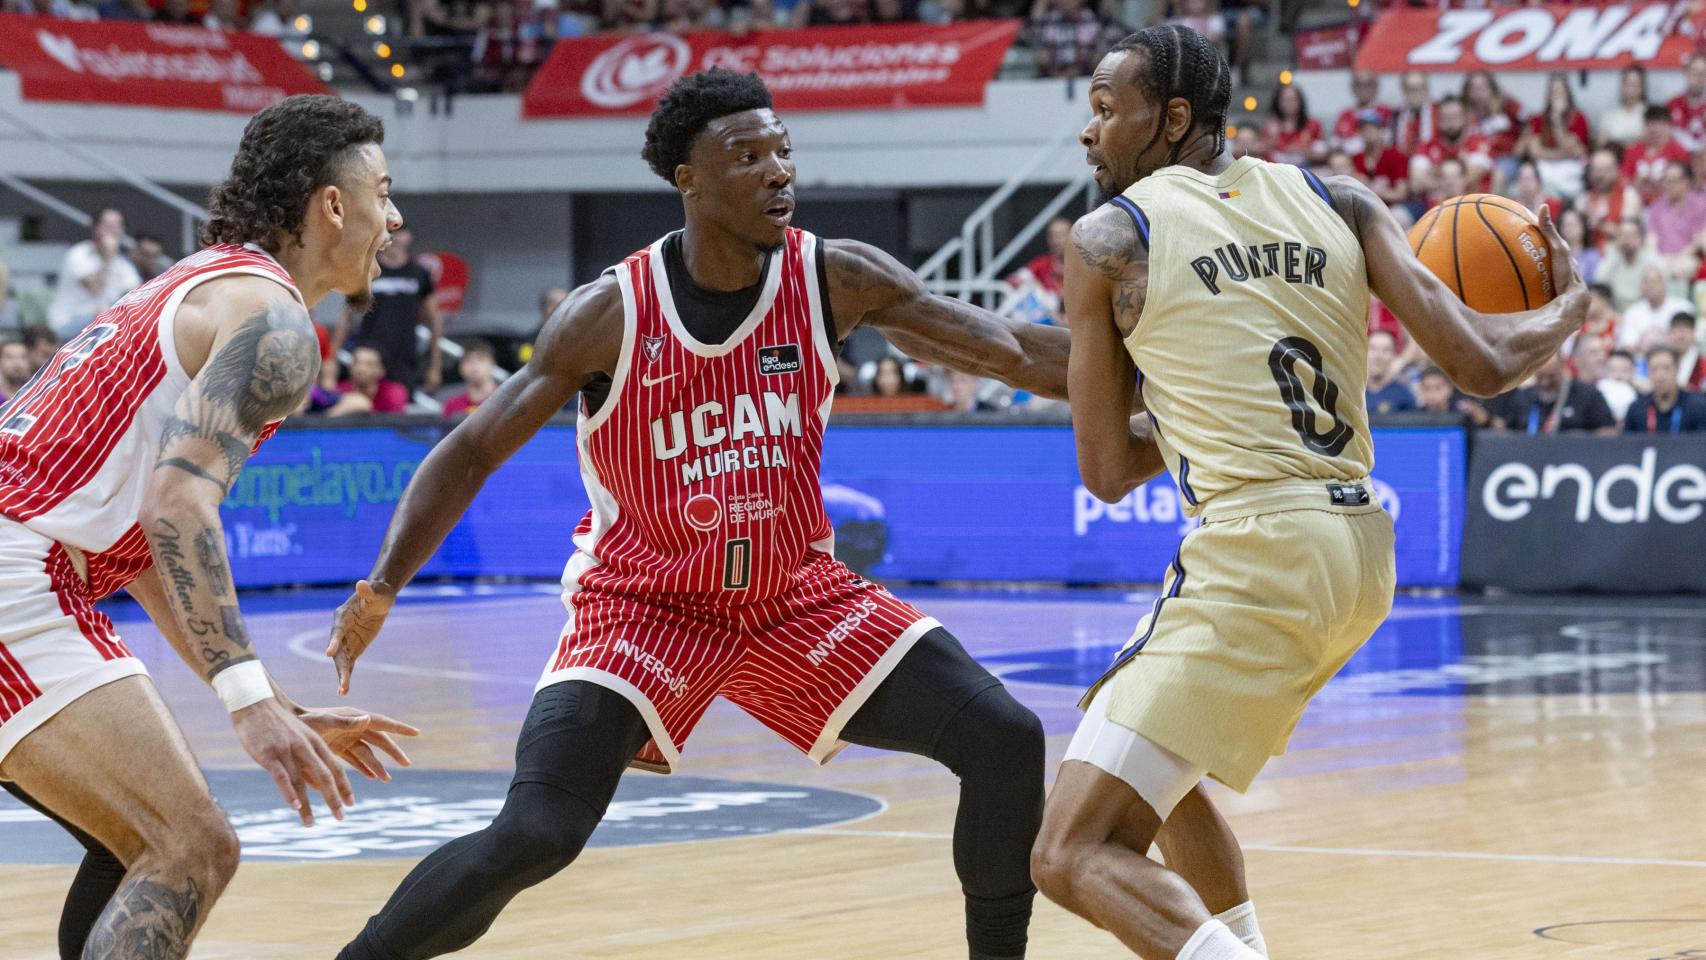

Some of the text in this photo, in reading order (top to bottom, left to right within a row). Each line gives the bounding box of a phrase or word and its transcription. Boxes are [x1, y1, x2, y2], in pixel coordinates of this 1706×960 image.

[1408, 7, 1666, 64] ZONA
[762, 355, 778, 365] liga
[763, 361, 798, 372] endesa
[1267, 336, 1354, 457] 0
[651, 391, 802, 461] UCAM
[681, 445, 788, 486] MURCIA
[730, 504, 784, 524] DE MURCA
[152, 518, 198, 616] Matthew
[723, 538, 752, 590] 0
[805, 595, 878, 667] INVERSUS
[613, 638, 691, 699] INVERSUS
